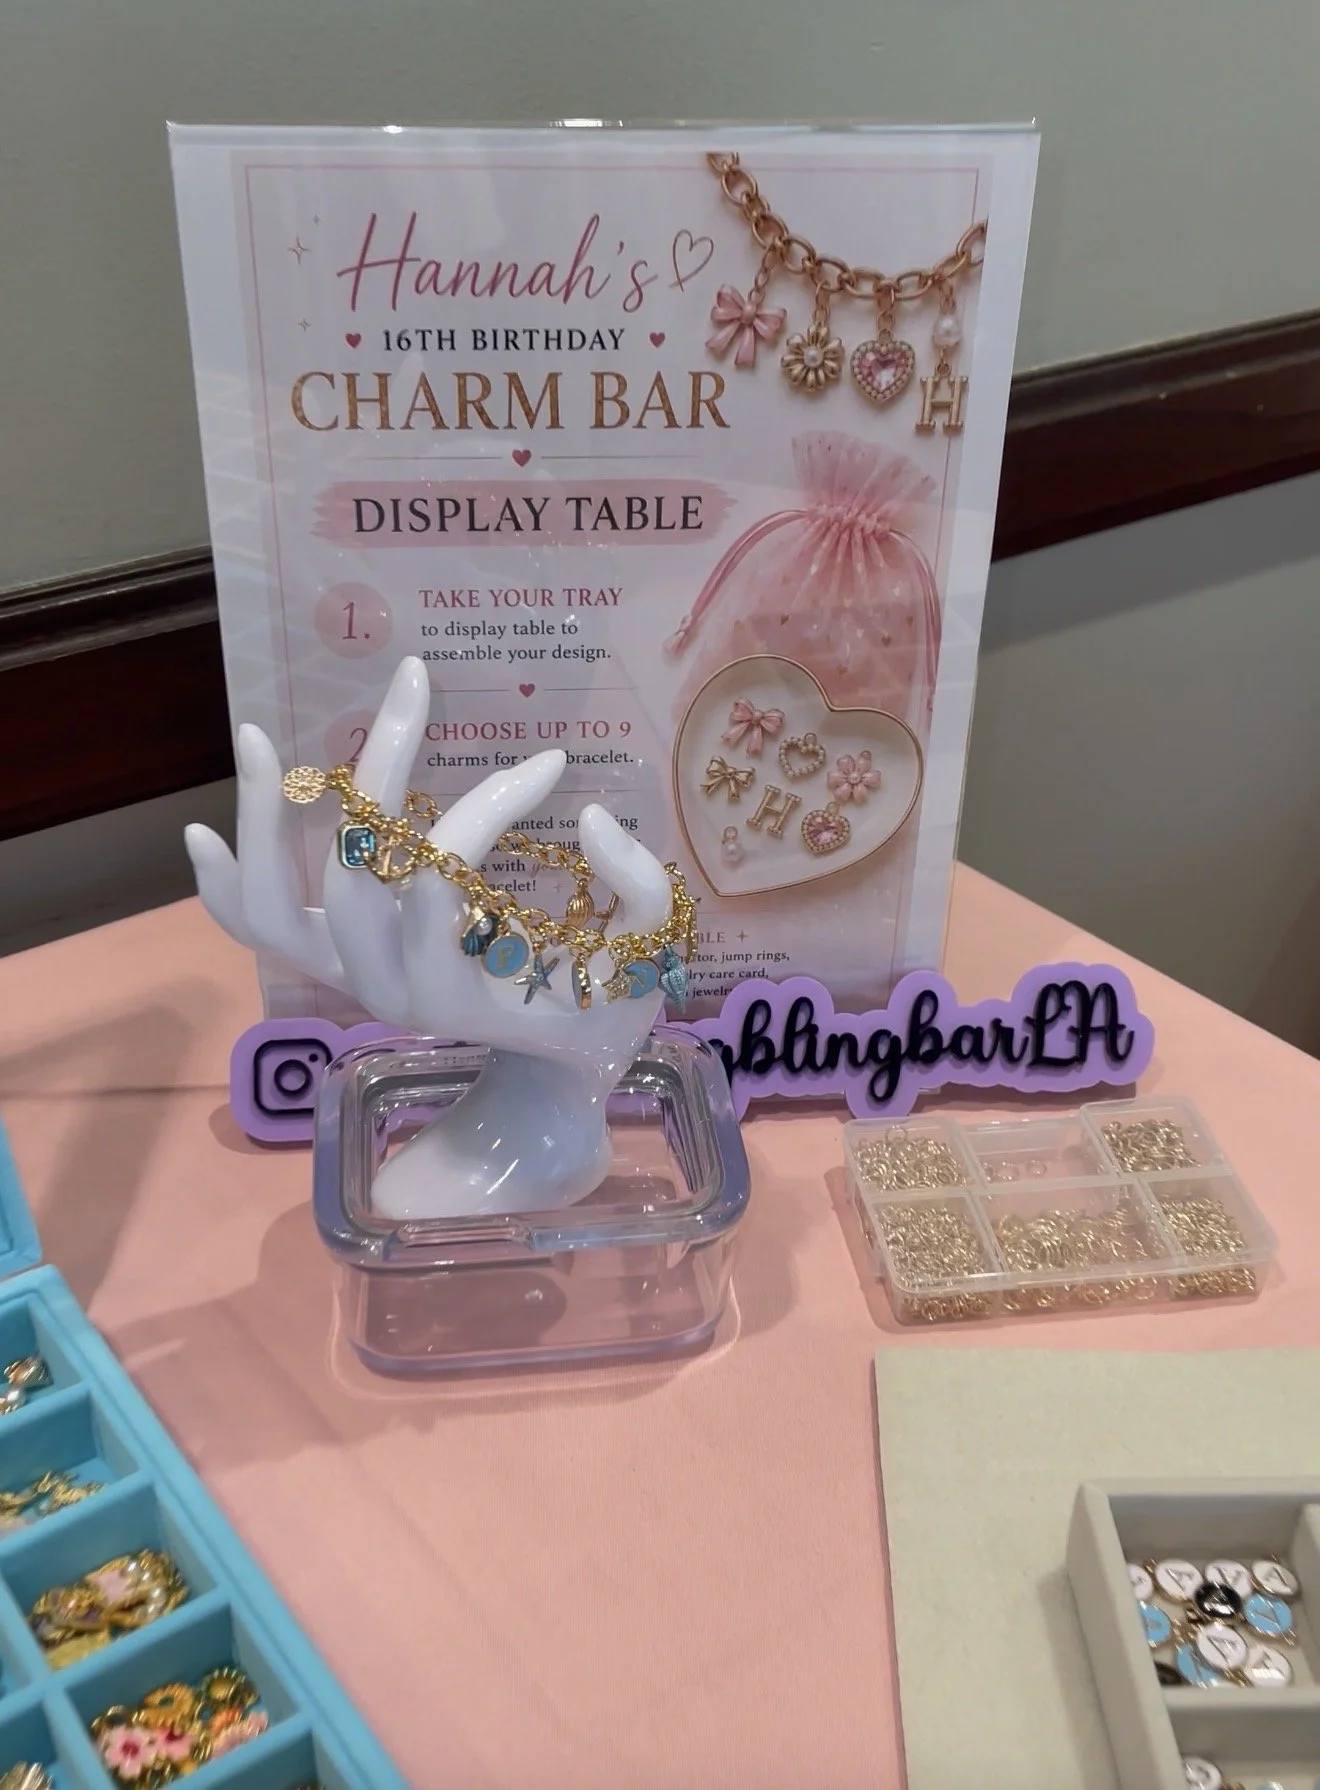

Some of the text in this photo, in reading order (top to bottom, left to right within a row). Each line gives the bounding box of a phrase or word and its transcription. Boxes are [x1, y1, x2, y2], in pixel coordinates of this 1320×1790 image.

[337, 211, 658, 313] Hannah's
[382, 328, 626, 352] 16TH BIRTHDAY
[291, 370, 731, 431] CHARM BAR
[353, 495, 704, 533] DISPLAY TABLE
[419, 587, 624, 609] TAKE YOUR TRAY
[342, 602, 370, 640] 1.
[421, 621, 578, 640] to display table to
[422, 645, 611, 664] assemble your design.
[425, 720, 632, 741] CHOOSE UP TO 9
[427, 752, 488, 767] charms
[494, 751, 518, 766] for
[566, 749, 634, 765] bracelet.
[511, 815, 554, 830] anted
[492, 858, 526, 872] with
[488, 879, 537, 892] acelet!
[697, 931, 726, 944] BLE
[721, 951, 753, 963] jump
[756, 949, 790, 963] rings,
[709, 970, 735, 979] care
[738, 967, 769, 979] card,
